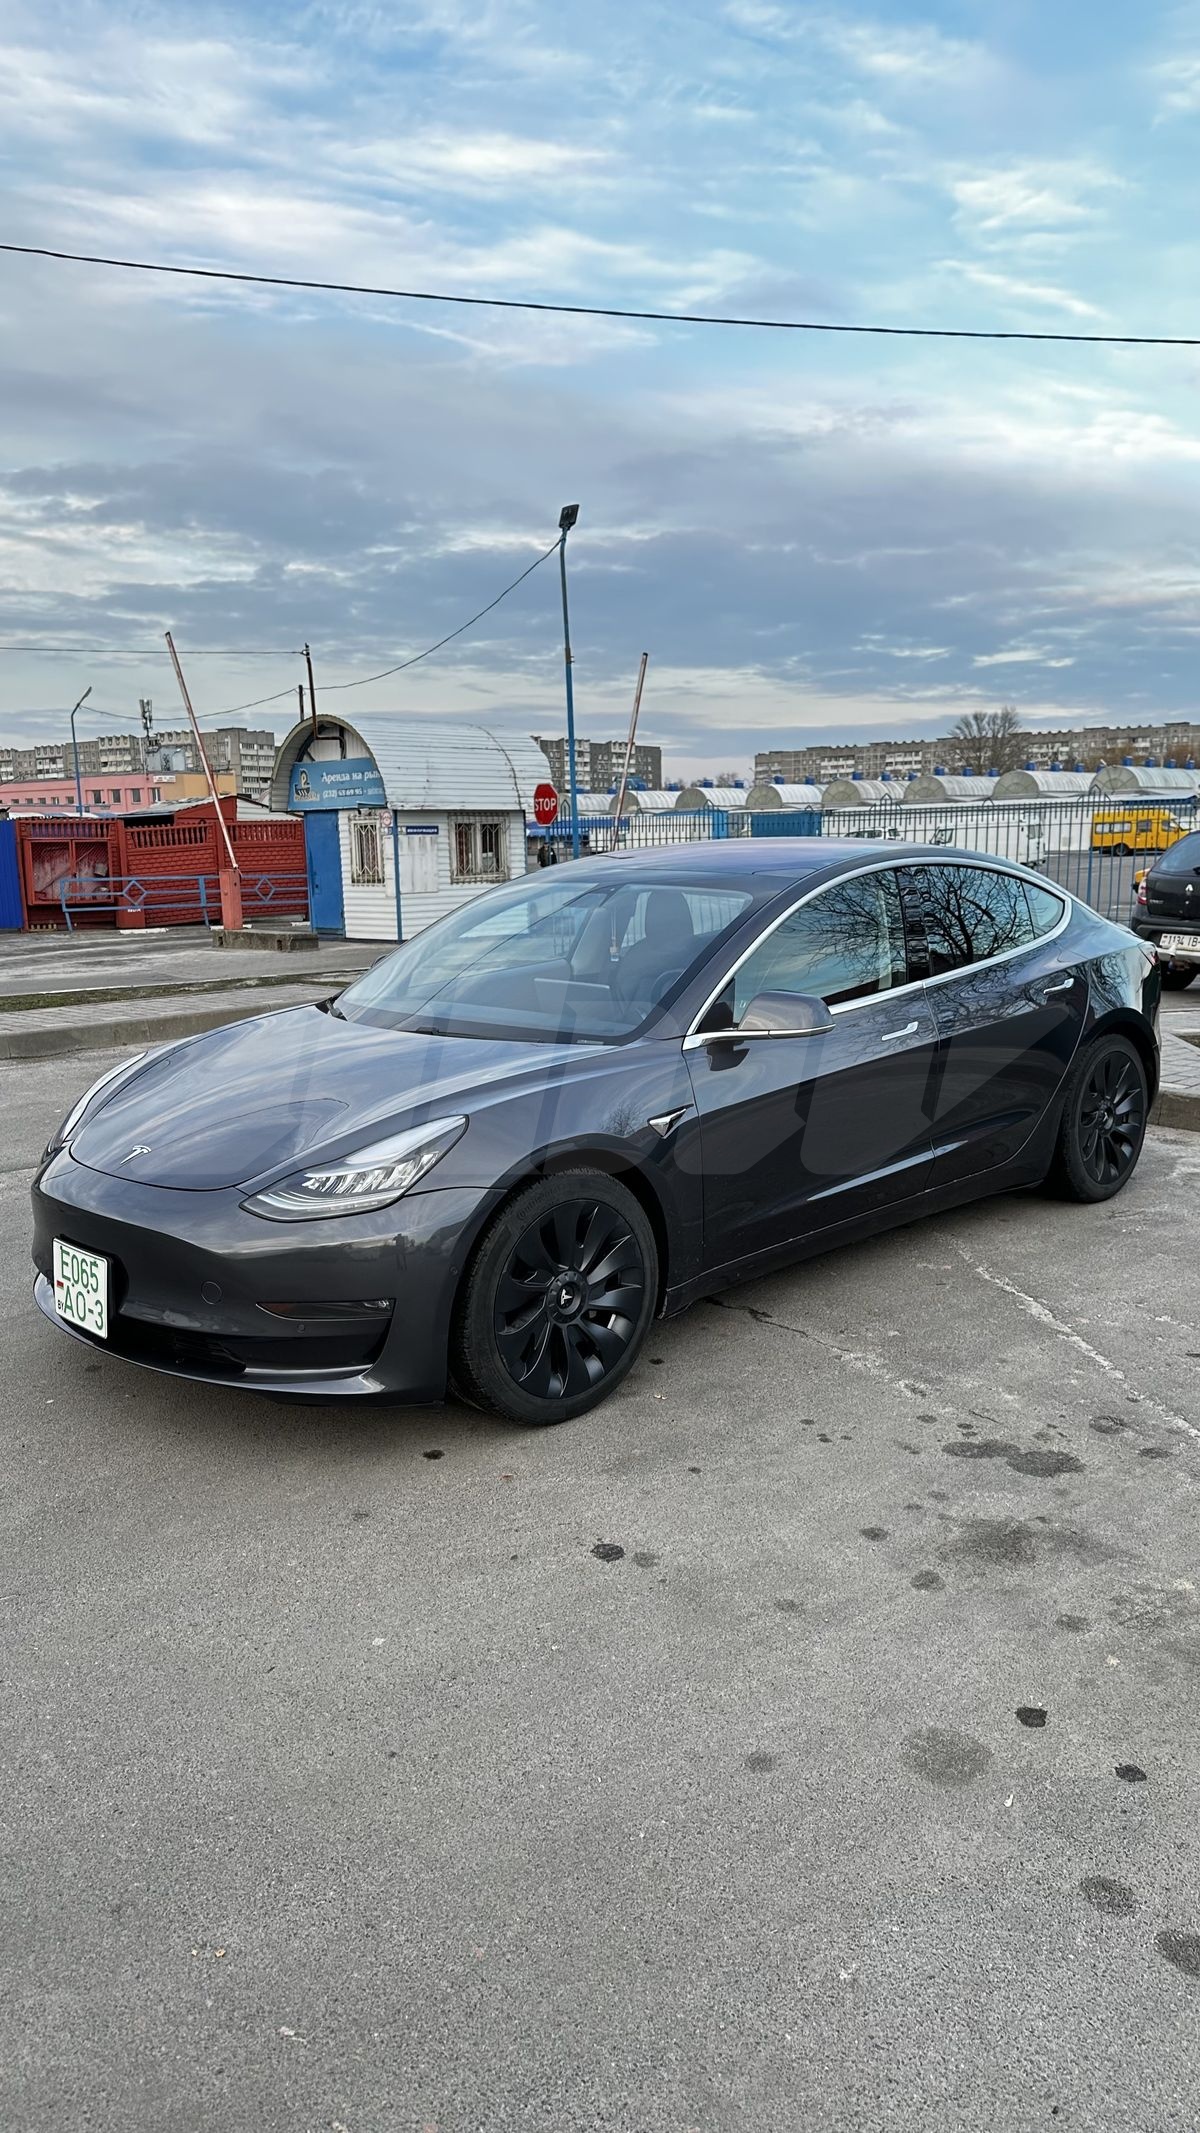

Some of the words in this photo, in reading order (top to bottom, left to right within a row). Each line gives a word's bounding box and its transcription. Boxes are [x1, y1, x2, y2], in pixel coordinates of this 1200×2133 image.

[321, 772, 350, 784] Аренда
[352, 772, 362, 780] на
[535, 798, 556, 811] STOP
[60, 1245, 99, 1293] E065
[57, 1299, 64, 1311] BY
[64, 1285, 104, 1331] AO-3
